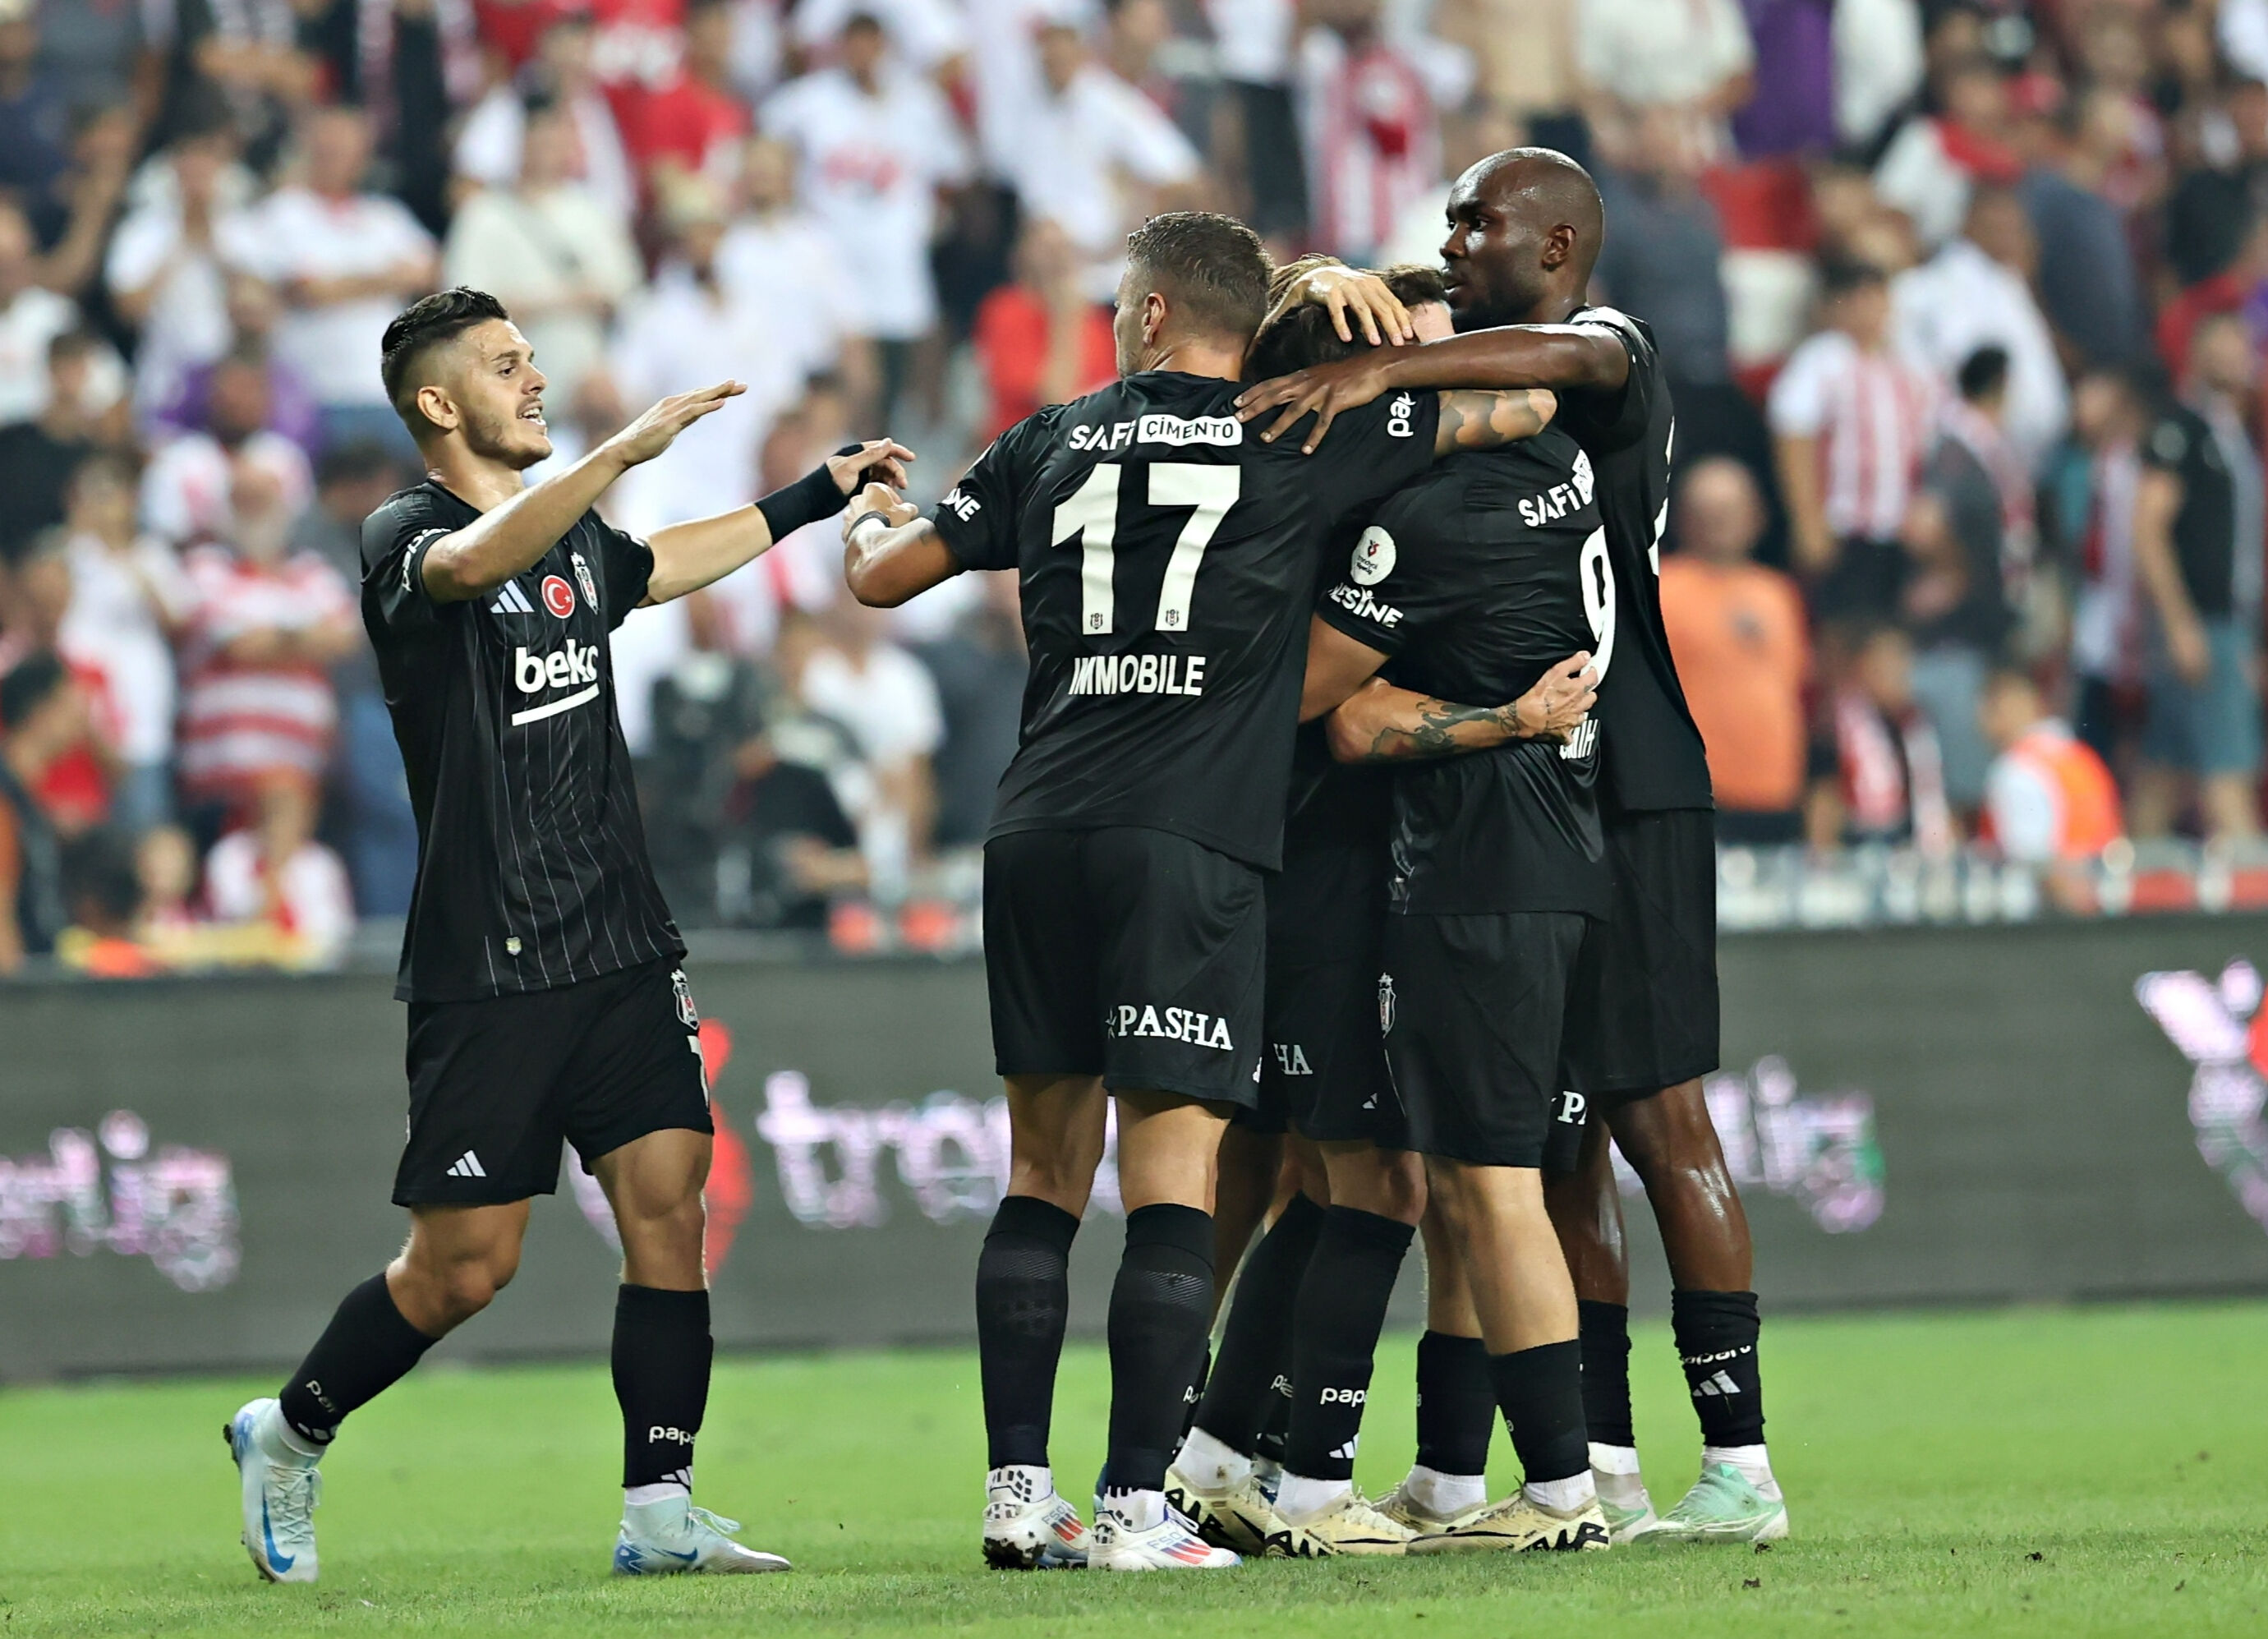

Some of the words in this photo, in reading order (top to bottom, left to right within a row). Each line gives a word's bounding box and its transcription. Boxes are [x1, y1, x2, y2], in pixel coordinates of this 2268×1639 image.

[1051, 462, 1241, 635] 17
[1068, 655, 1207, 697] IMMOBILE
[1117, 1005, 1234, 1051] PASHA
